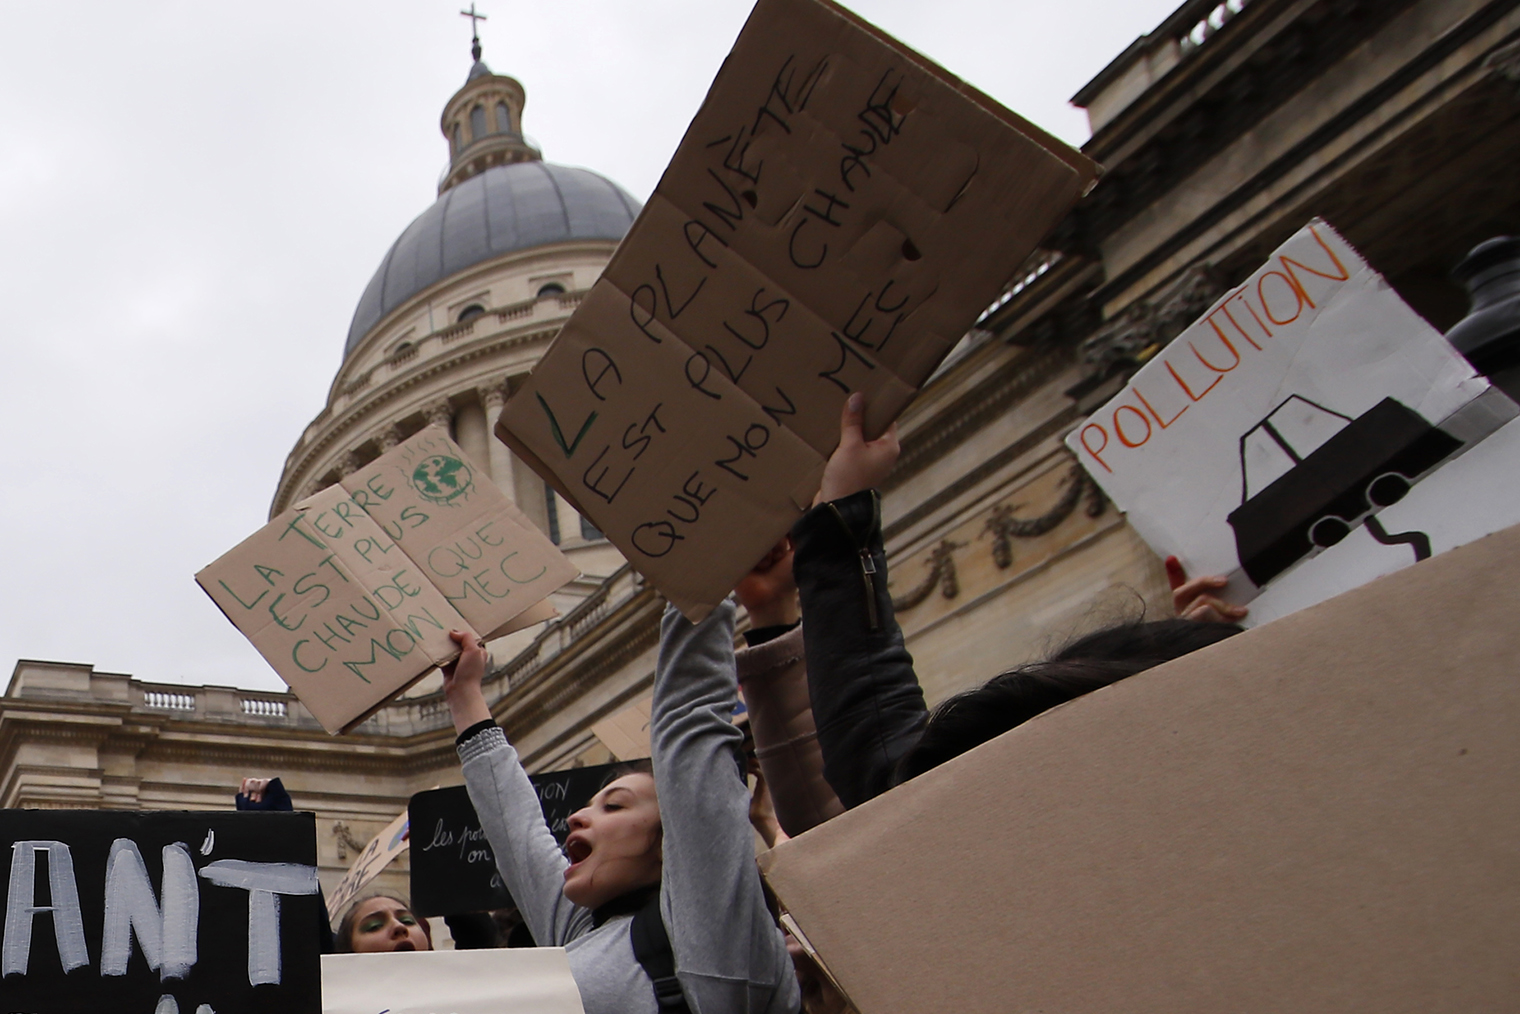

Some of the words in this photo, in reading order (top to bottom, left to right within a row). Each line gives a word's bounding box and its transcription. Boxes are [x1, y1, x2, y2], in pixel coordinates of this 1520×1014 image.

[582, 402, 666, 504] EST
[684, 286, 791, 400] PLUS
[789, 67, 907, 269] CHAUDE
[1079, 225, 1350, 474] POLLUTION
[535, 347, 622, 459] LA
[631, 470, 718, 558] QUE
[714, 386, 797, 481] MON
[818, 279, 910, 394] MEC
[218, 564, 284, 610] LA
[278, 473, 396, 550] TERRE
[268, 553, 350, 632] EST
[353, 505, 431, 564] PLUS
[291, 569, 422, 673] CHAUDE
[427, 521, 505, 578] QUE
[342, 606, 445, 684] MON
[444, 551, 547, 605] MEC
